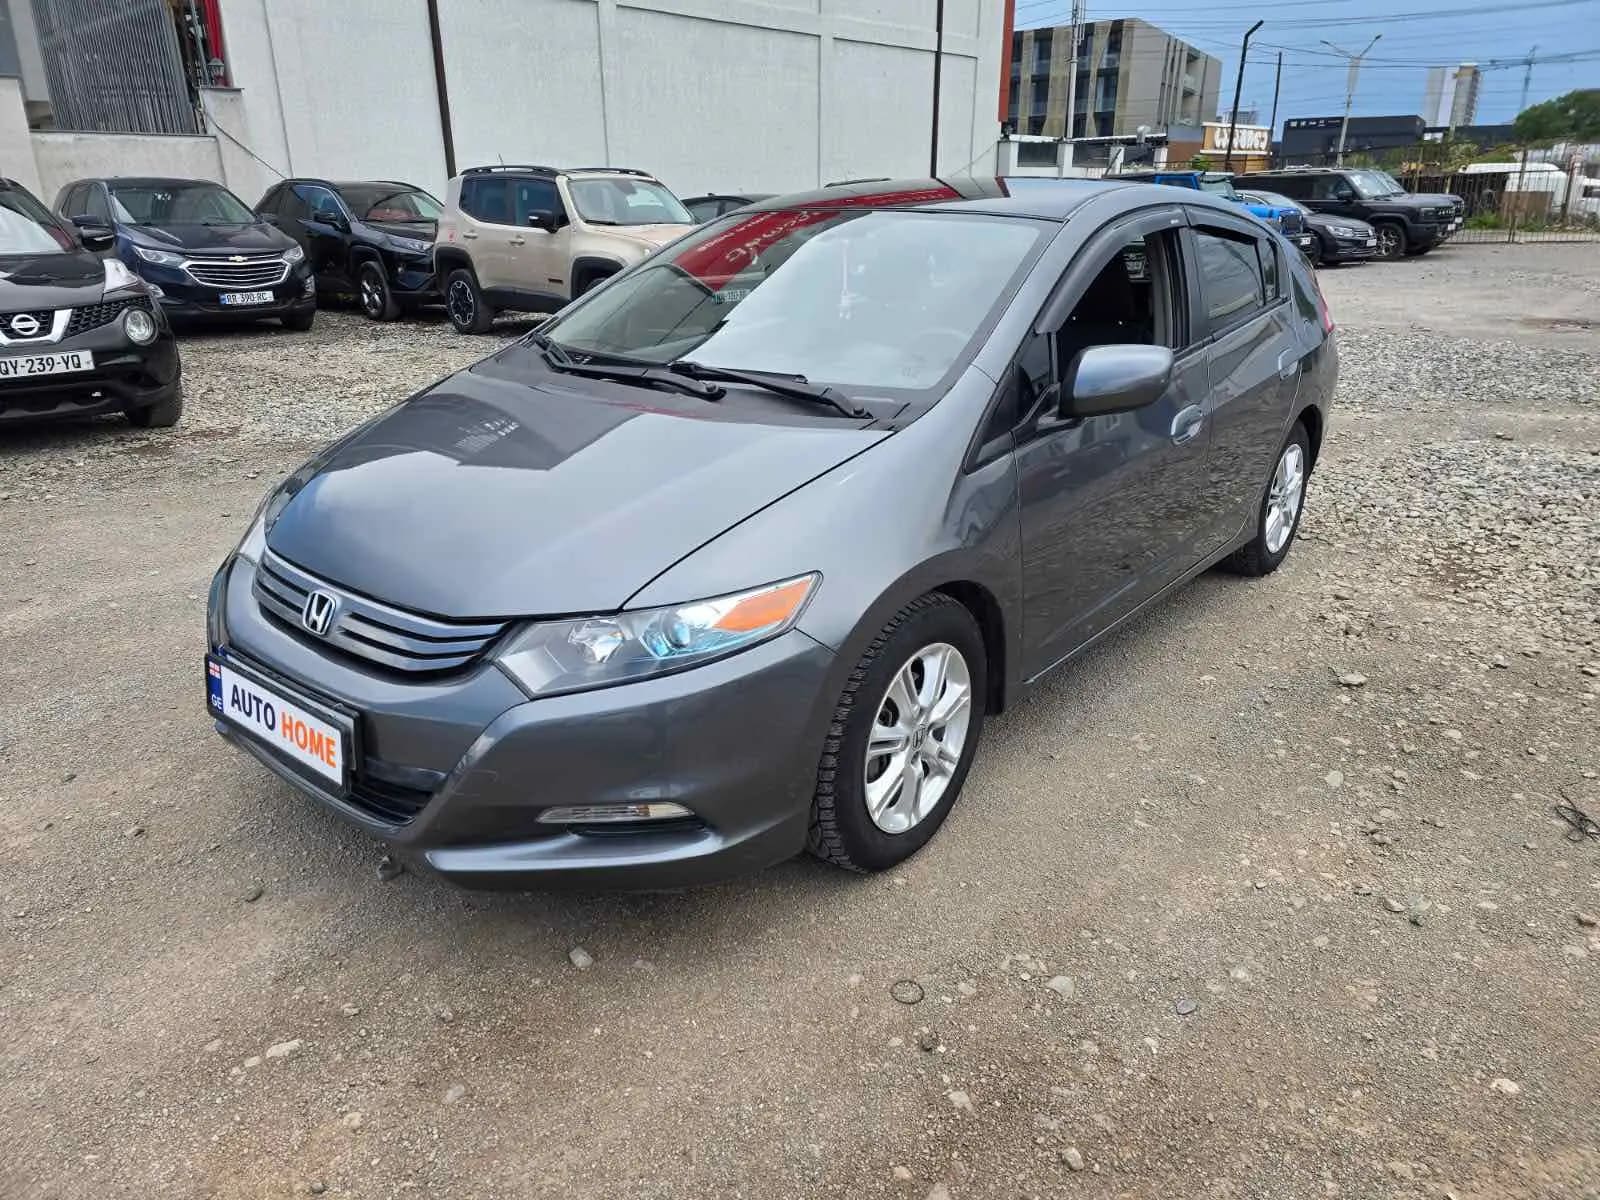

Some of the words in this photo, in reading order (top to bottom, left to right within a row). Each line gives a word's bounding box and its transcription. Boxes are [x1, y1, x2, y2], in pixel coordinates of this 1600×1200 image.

[211, 693, 223, 711] GE
[230, 684, 276, 732] AUTO
[281, 711, 337, 769] HOME
